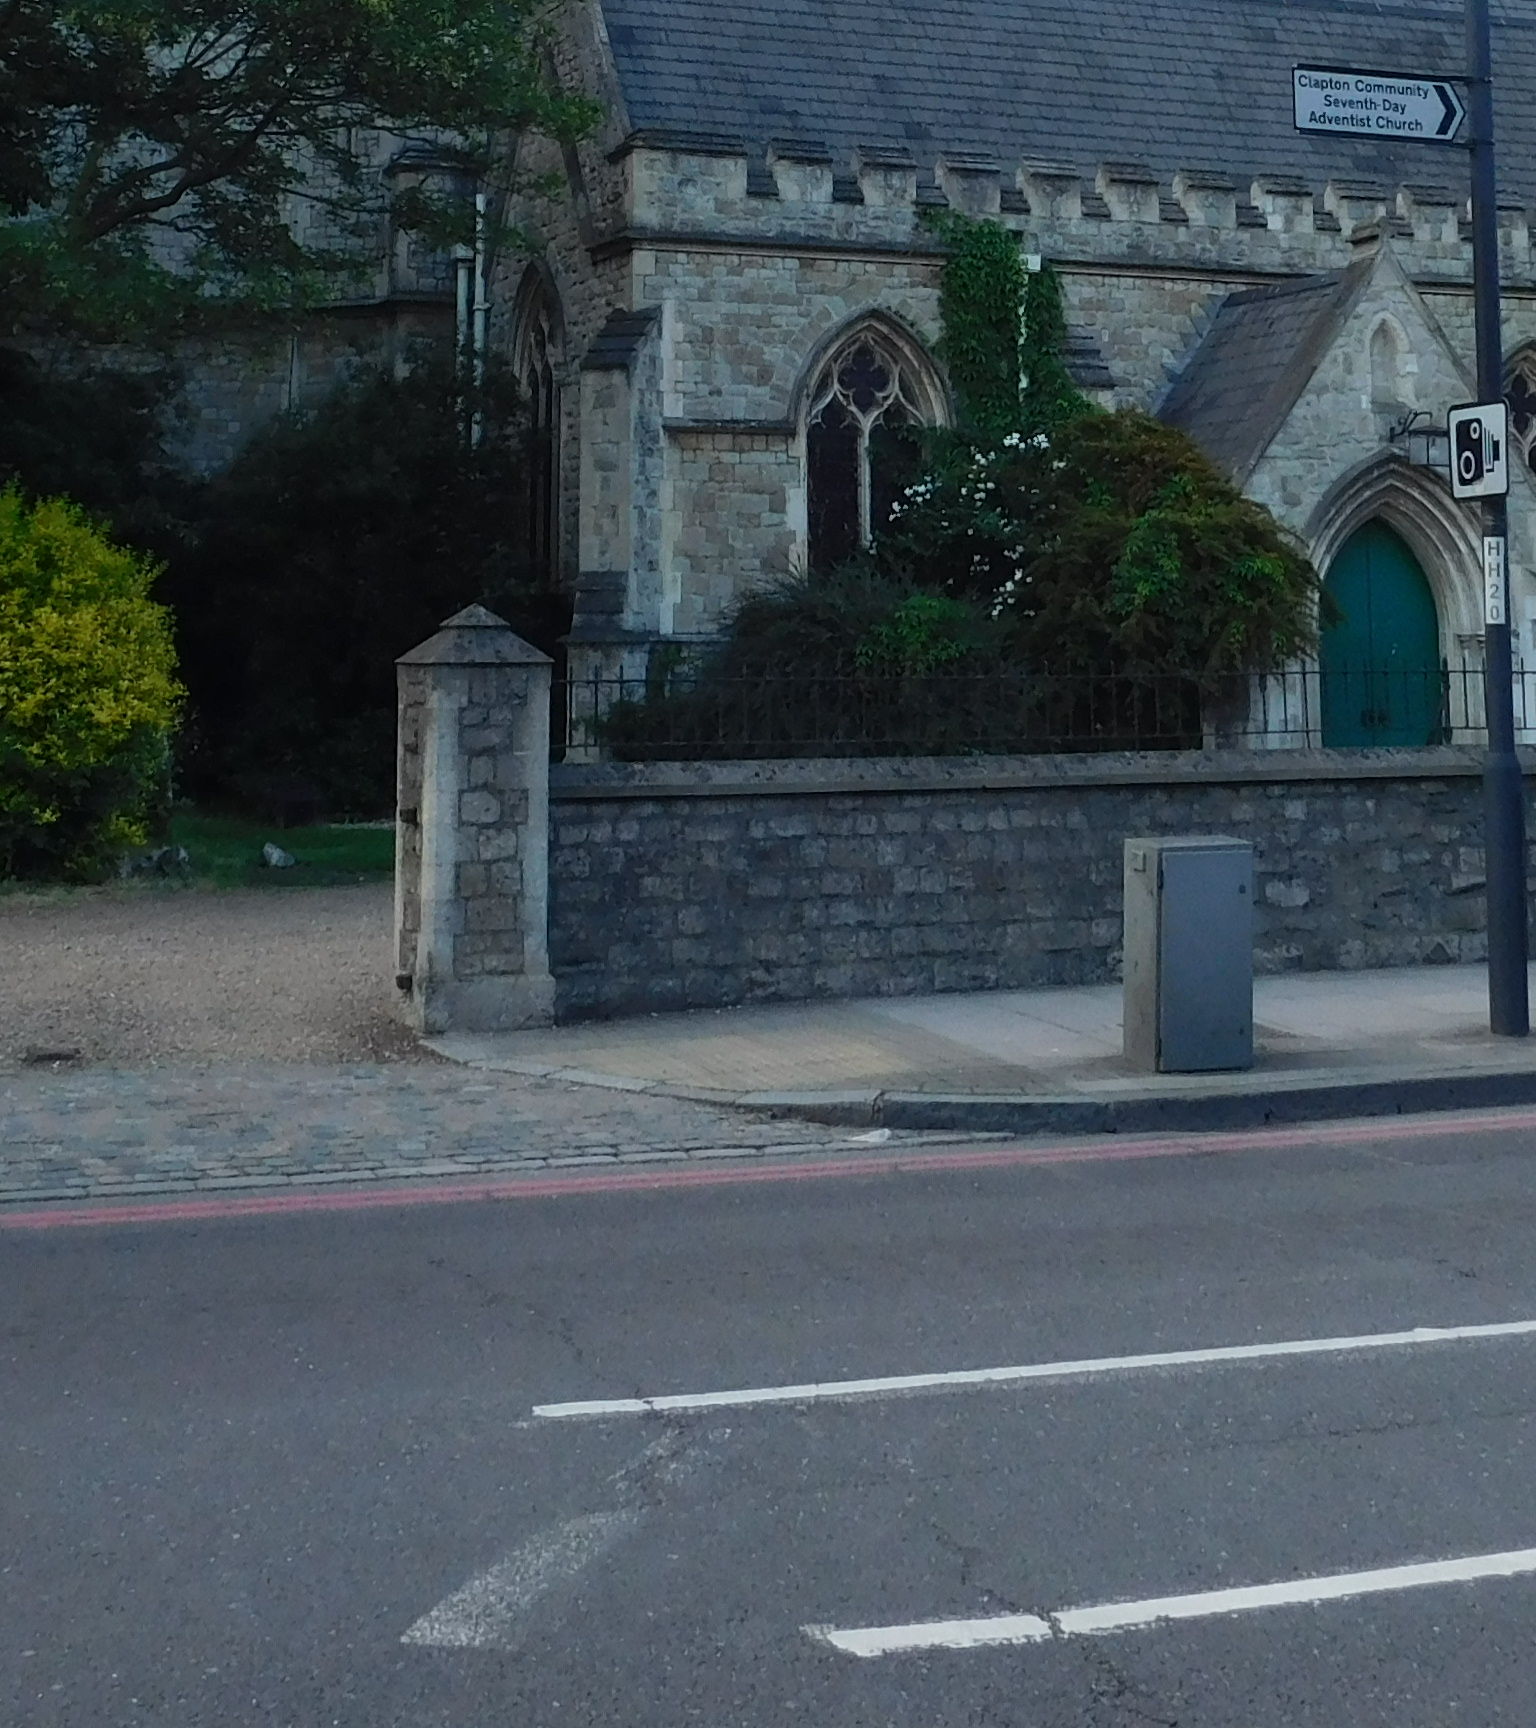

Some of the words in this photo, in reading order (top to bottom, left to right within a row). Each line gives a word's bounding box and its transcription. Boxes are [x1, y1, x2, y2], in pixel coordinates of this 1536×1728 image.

[1298, 74, 1350, 91] Clapton
[1355, 79, 1430, 100] Community
[1323, 94, 1407, 115] Seventh-Day
[1309, 111, 1372, 128] Adventist
[1375, 116, 1424, 132] Church
